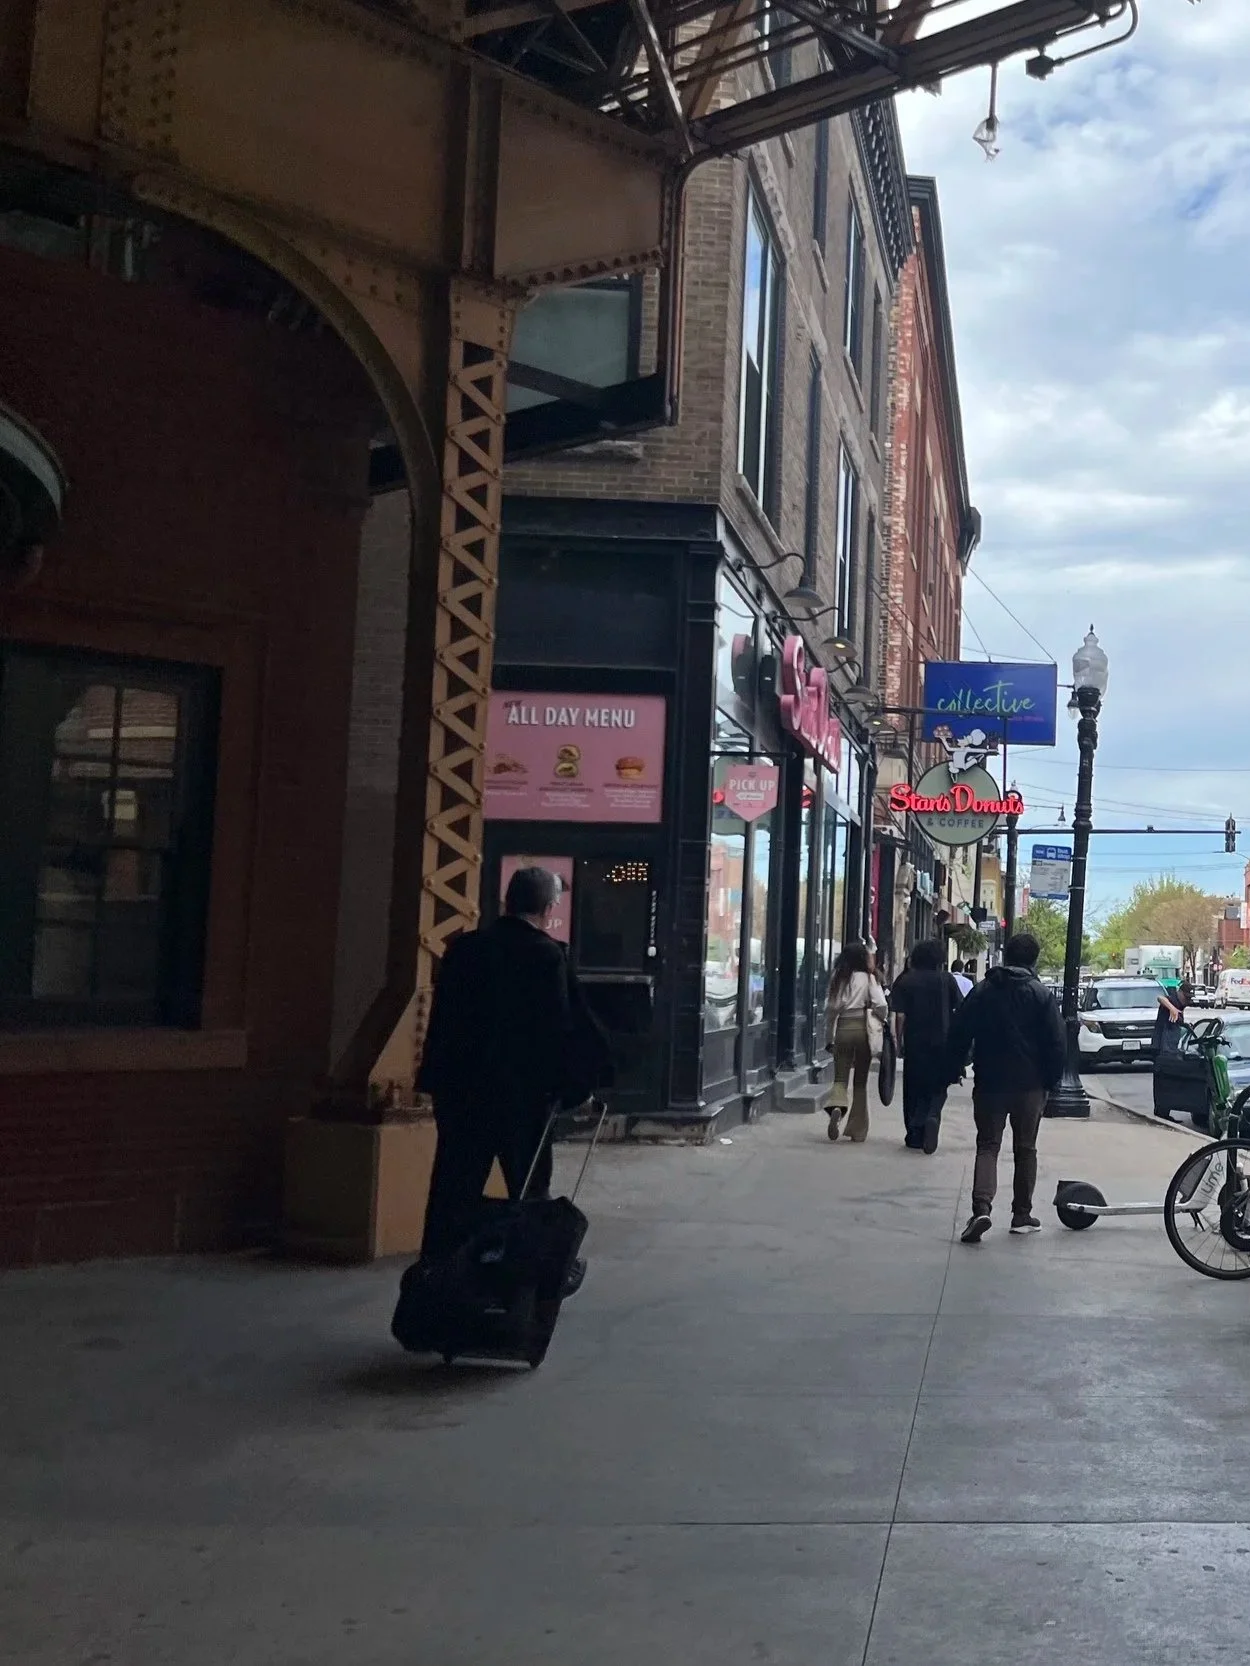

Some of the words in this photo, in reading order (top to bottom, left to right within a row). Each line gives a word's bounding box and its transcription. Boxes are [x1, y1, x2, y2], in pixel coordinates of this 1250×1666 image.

[937, 680, 1035, 715] collective
[508, 704, 538, 725] ALL
[545, 707, 579, 726] DAY
[585, 709, 635, 728] MENU
[729, 779, 757, 791] PICK
[759, 780, 776, 791] UP
[889, 784, 950, 813] Stan's
[951, 784, 1024, 815] Donuts
[926, 817, 934, 826] &
[940, 818, 984, 828] COFFEE
[1201, 1163, 1223, 1194] Lime
